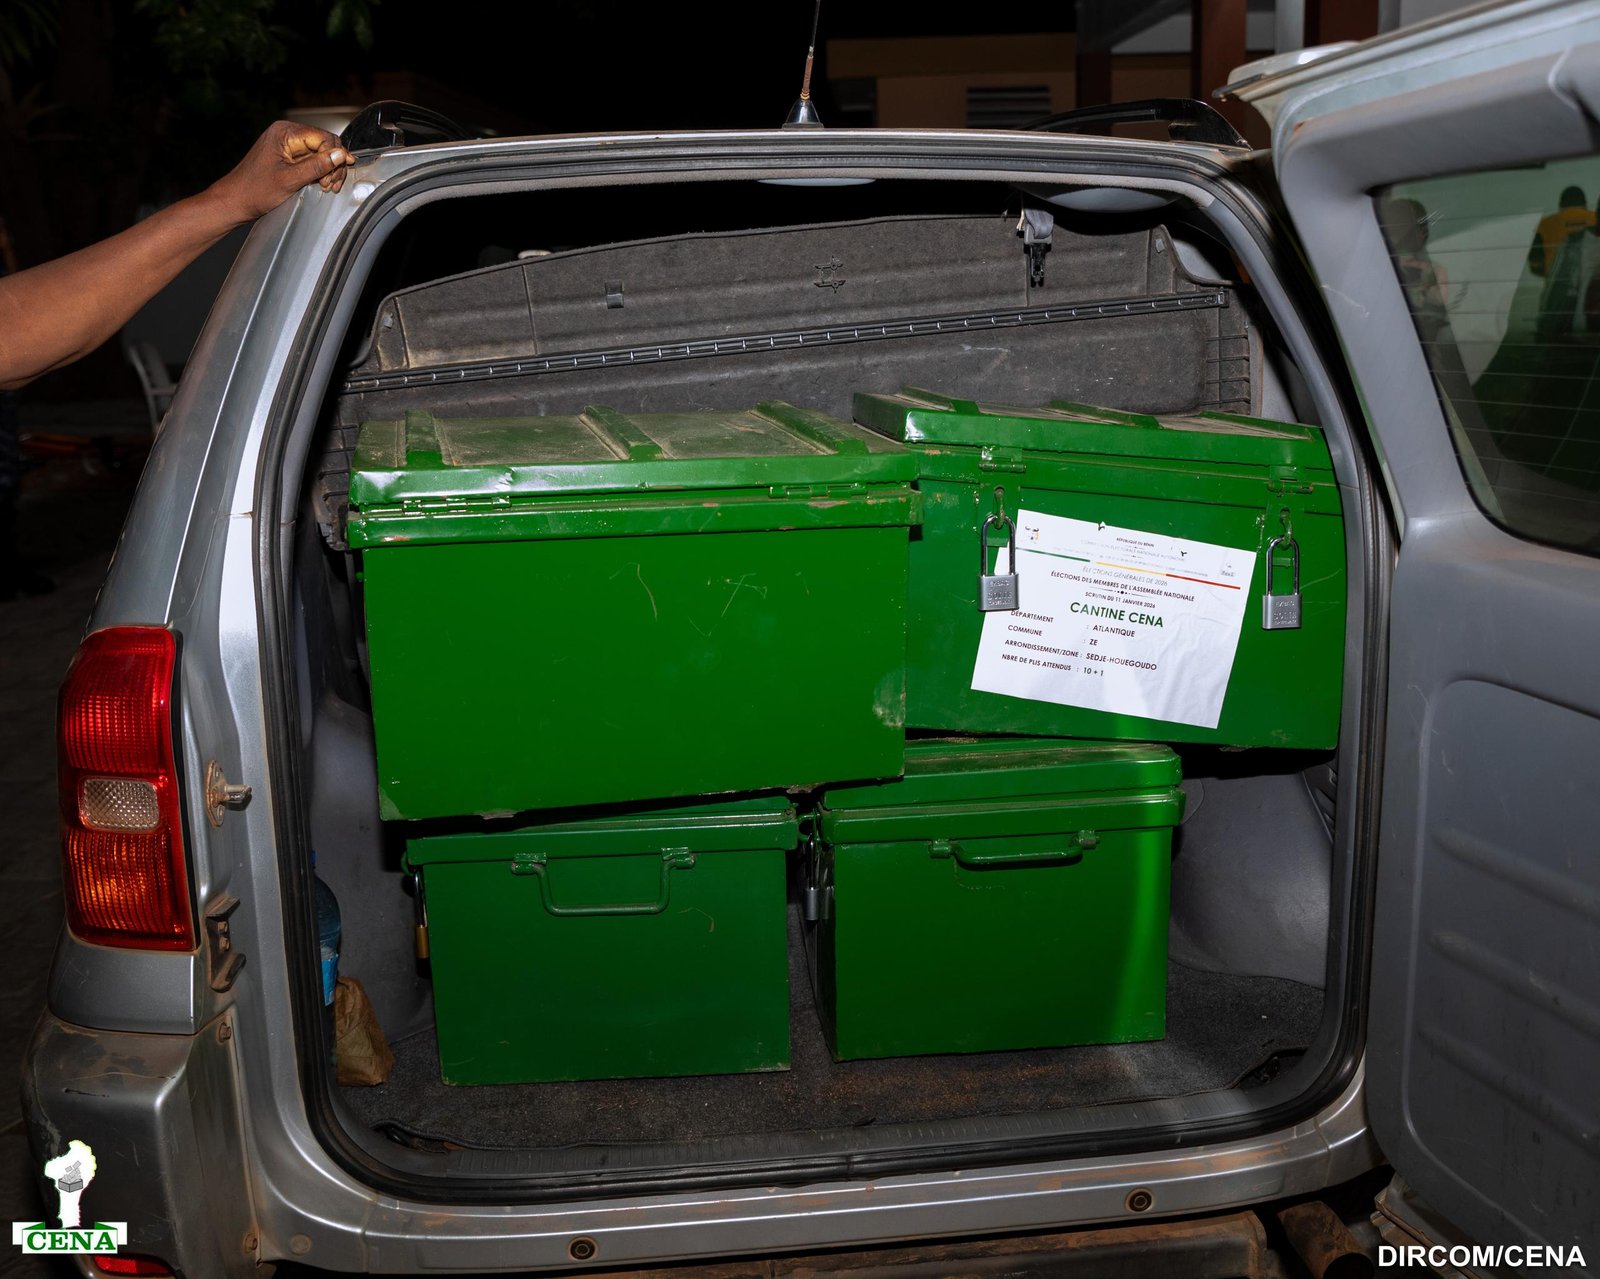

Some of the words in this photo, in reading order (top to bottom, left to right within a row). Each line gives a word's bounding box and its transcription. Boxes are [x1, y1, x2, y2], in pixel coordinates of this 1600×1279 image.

[1051, 570, 1081, 582] ÉLECTIONS
[1081, 576, 1092, 584] DES
[1093, 579, 1120, 588] MEMBRES
[1129, 585, 1163, 596] L'ASSEMBLÉE
[1164, 591, 1195, 602] NATIONALE
[1113, 572, 1145, 583] GÉNÉRALES
[1154, 579, 1168, 587] 2026
[1085, 591, 1107, 600] SCRUTIN
[1122, 598, 1143, 606] JANVIER
[1011, 610, 1054, 623] DÉPARTEMENT
[1093, 625, 1135, 637] ATLANTIQUE
[1070, 602, 1126, 621] CANTINE
[1128, 612, 1163, 628] CENA
[1008, 625, 1043, 636] COMMUNE
[1002, 654, 1018, 662] NBRE
[1042, 661, 1072, 671] ATTENDUS
[1084, 667, 1092, 675] 10
[1005, 639, 1079, 658] ARRONDISSEMENT/ZONE
[1086, 653, 1157, 671] SEDJE-HOUEGOUDO
